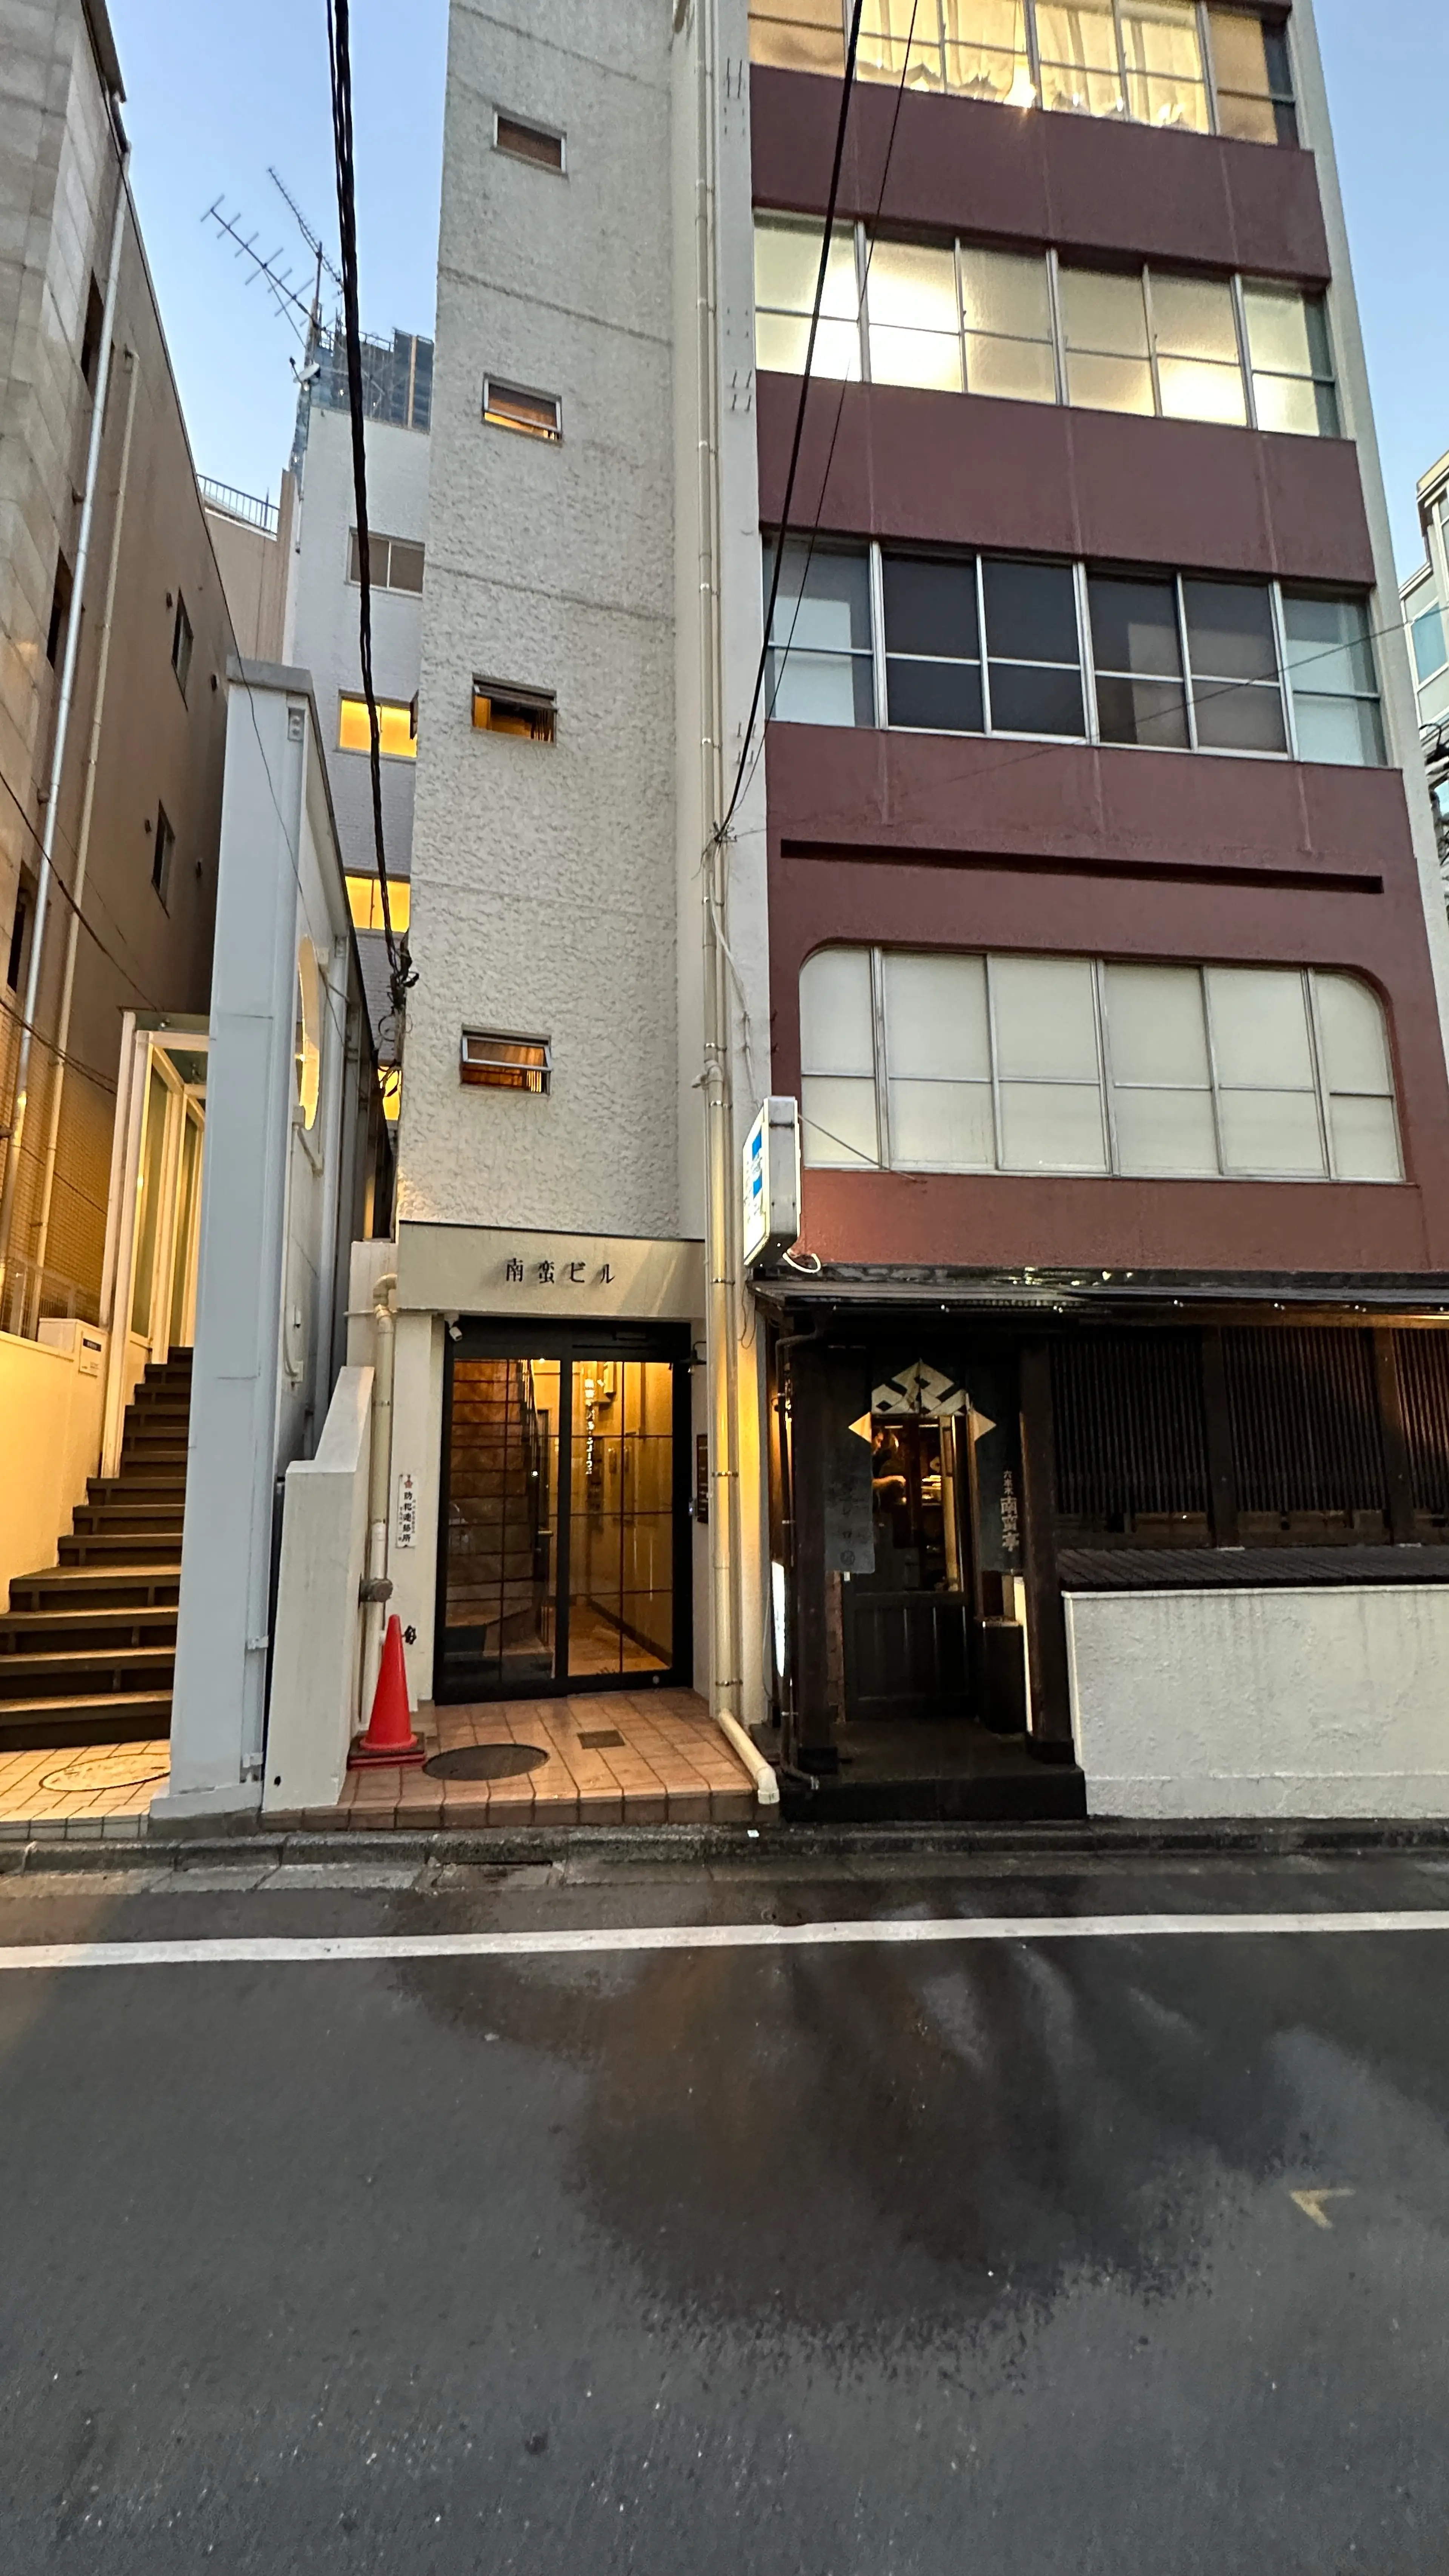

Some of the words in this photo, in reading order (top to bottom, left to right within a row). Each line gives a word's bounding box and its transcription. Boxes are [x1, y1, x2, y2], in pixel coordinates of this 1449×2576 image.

[506, 1258, 615, 1284] 南蛮ビル
[401, 1491, 413, 1543] 防犯連絡所
